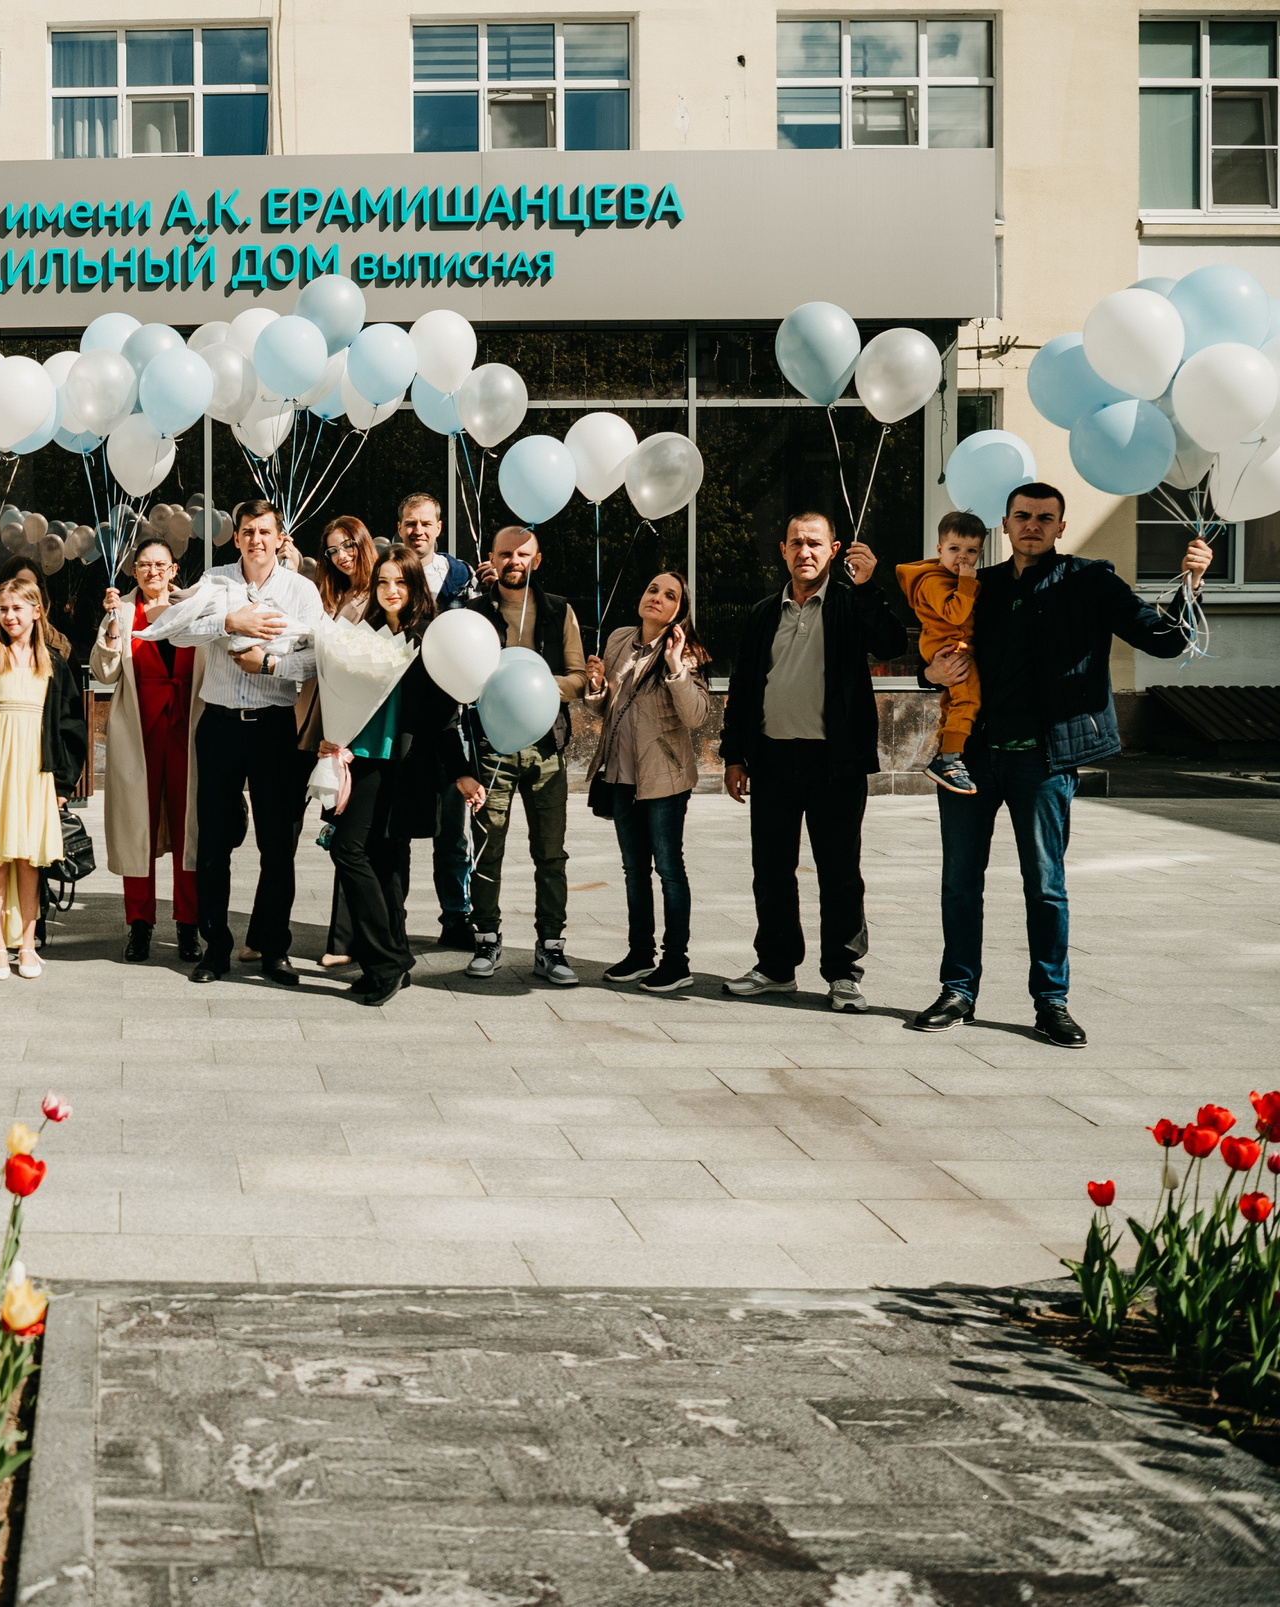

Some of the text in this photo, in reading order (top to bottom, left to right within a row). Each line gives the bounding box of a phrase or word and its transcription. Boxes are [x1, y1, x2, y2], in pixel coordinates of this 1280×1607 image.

[5, 200, 152, 231] имени
[166, 188, 252, 227] А.К.
[267, 182, 685, 228] ЕРАМИШАНЦЕВА
[231, 242, 340, 289] ДОМ
